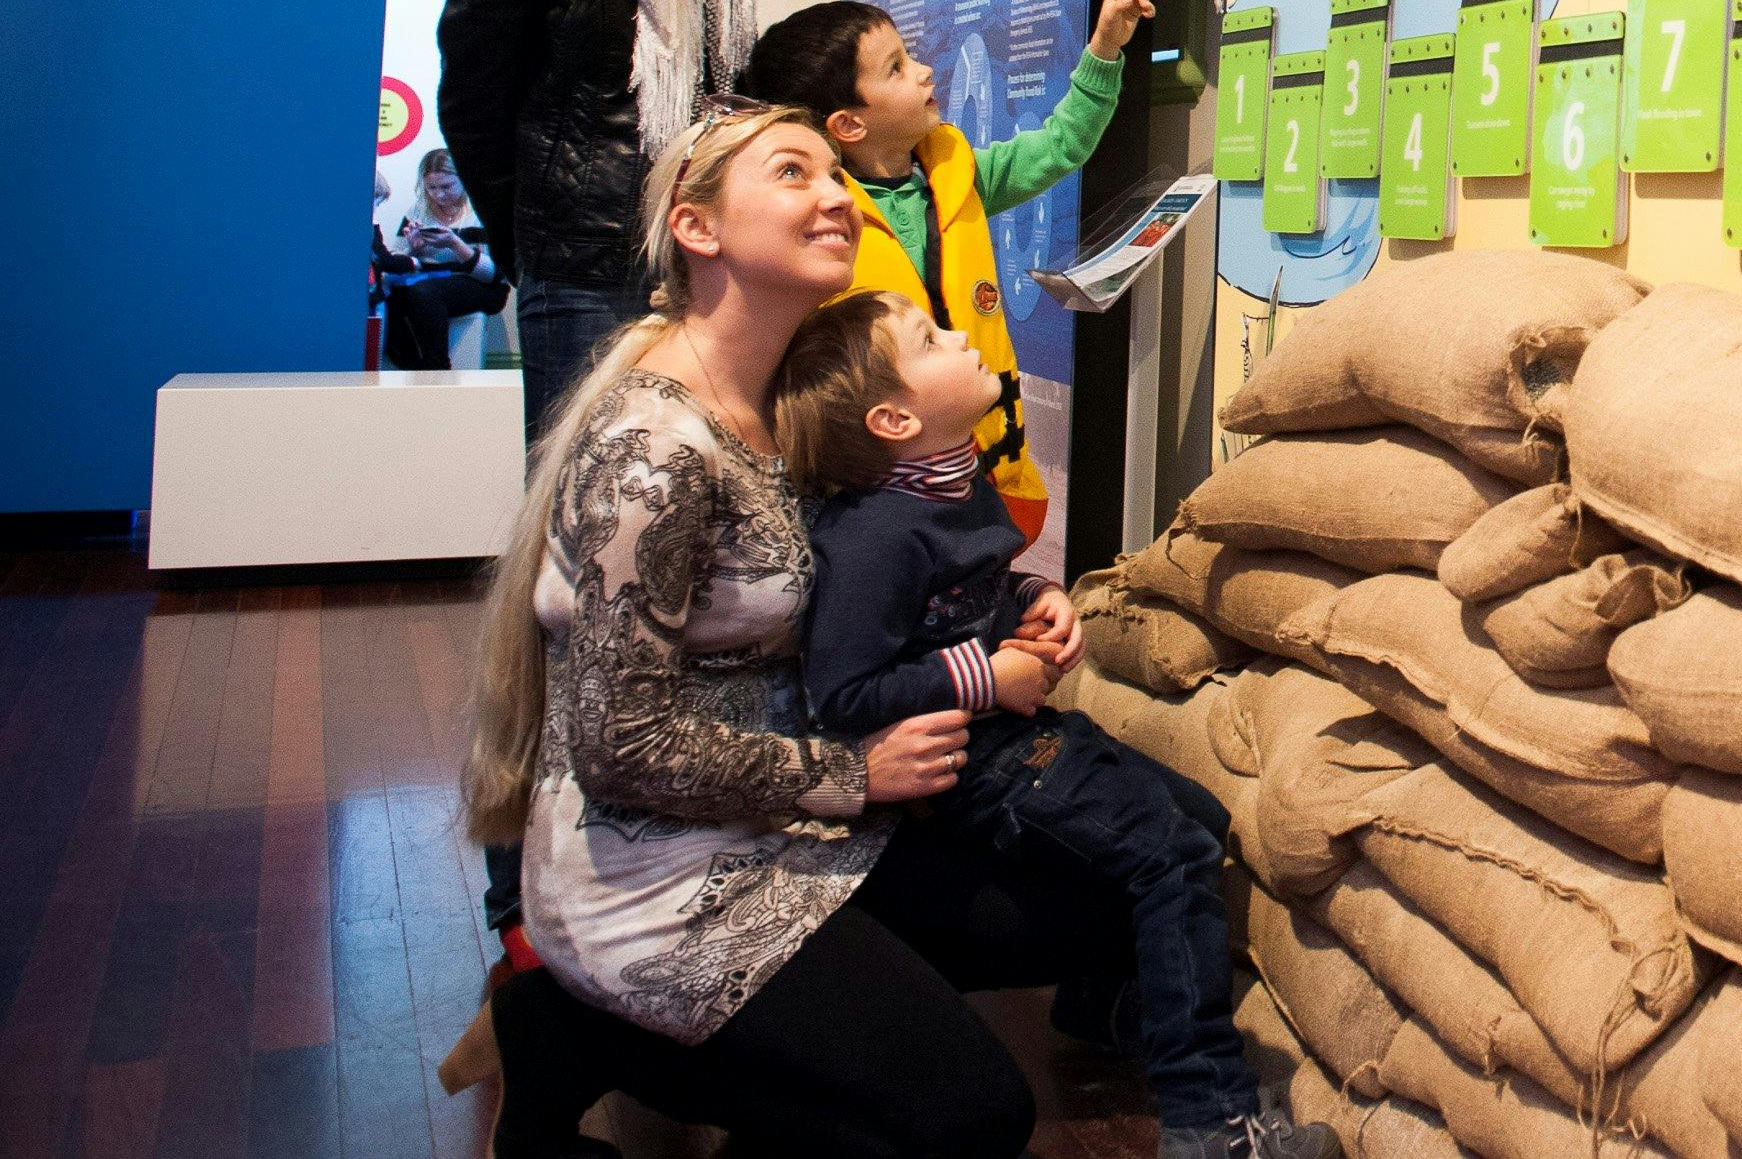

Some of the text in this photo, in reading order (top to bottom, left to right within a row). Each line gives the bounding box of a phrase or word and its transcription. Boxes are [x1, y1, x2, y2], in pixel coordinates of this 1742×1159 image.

[1481, 42, 1500, 105] 5
[1661, 19, 1685, 93] 7
[1235, 75, 1245, 123] 1
[1344, 59, 1360, 116] 3
[1284, 120, 1299, 172] 2
[1404, 114, 1422, 171] 4
[1563, 101, 1585, 170] 6
